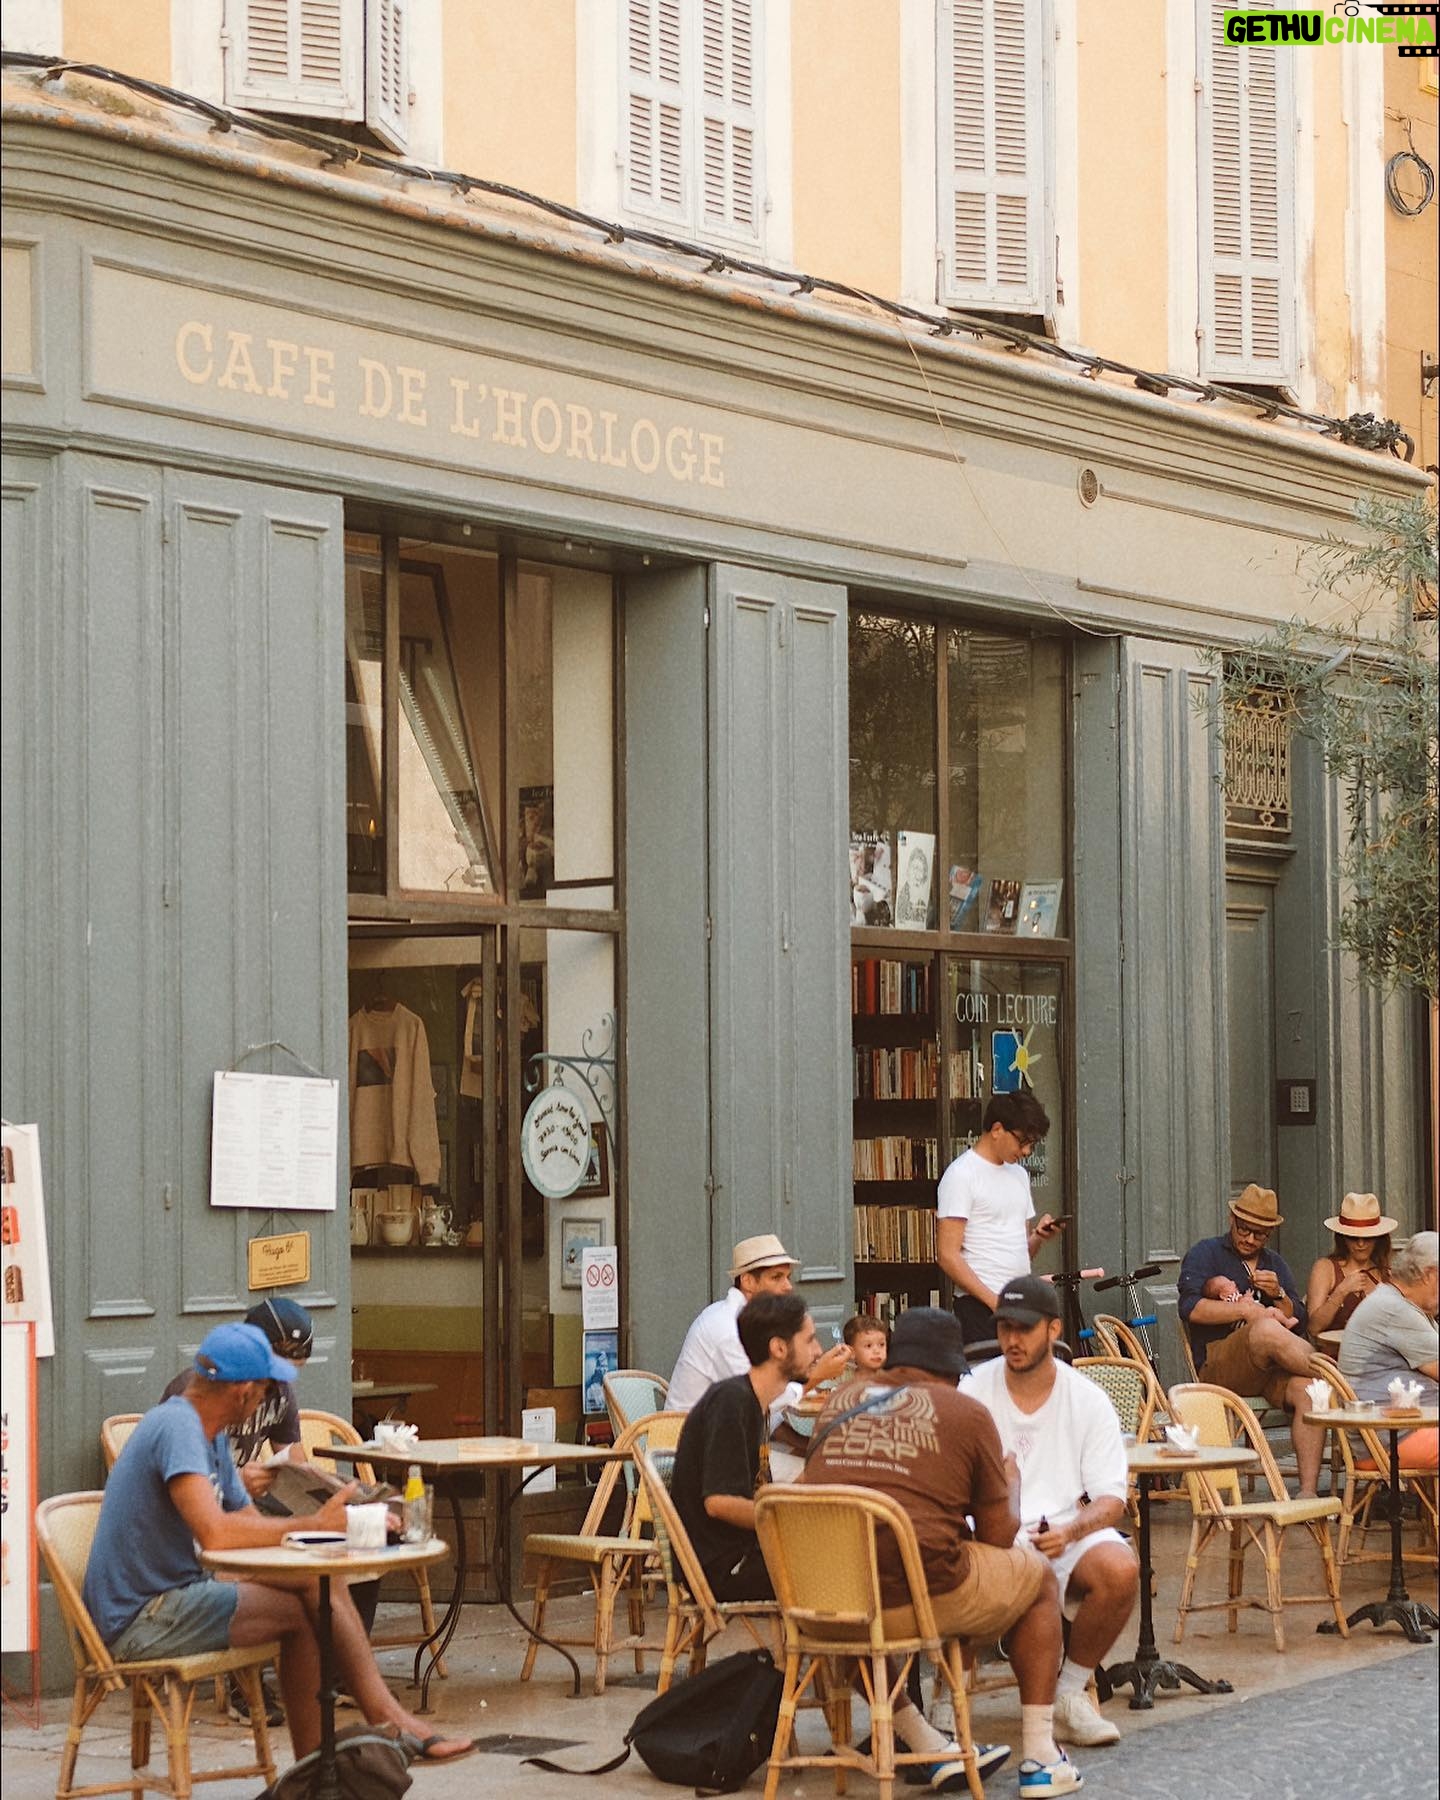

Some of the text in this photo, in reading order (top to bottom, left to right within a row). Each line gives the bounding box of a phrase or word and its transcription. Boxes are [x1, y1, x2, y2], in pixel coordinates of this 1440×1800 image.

[175, 320, 725, 488] CAFE DE L'HORLOGE
[955, 991, 1057, 1026] COIN LECTURE
[822, 1436, 919, 1461] CORP
